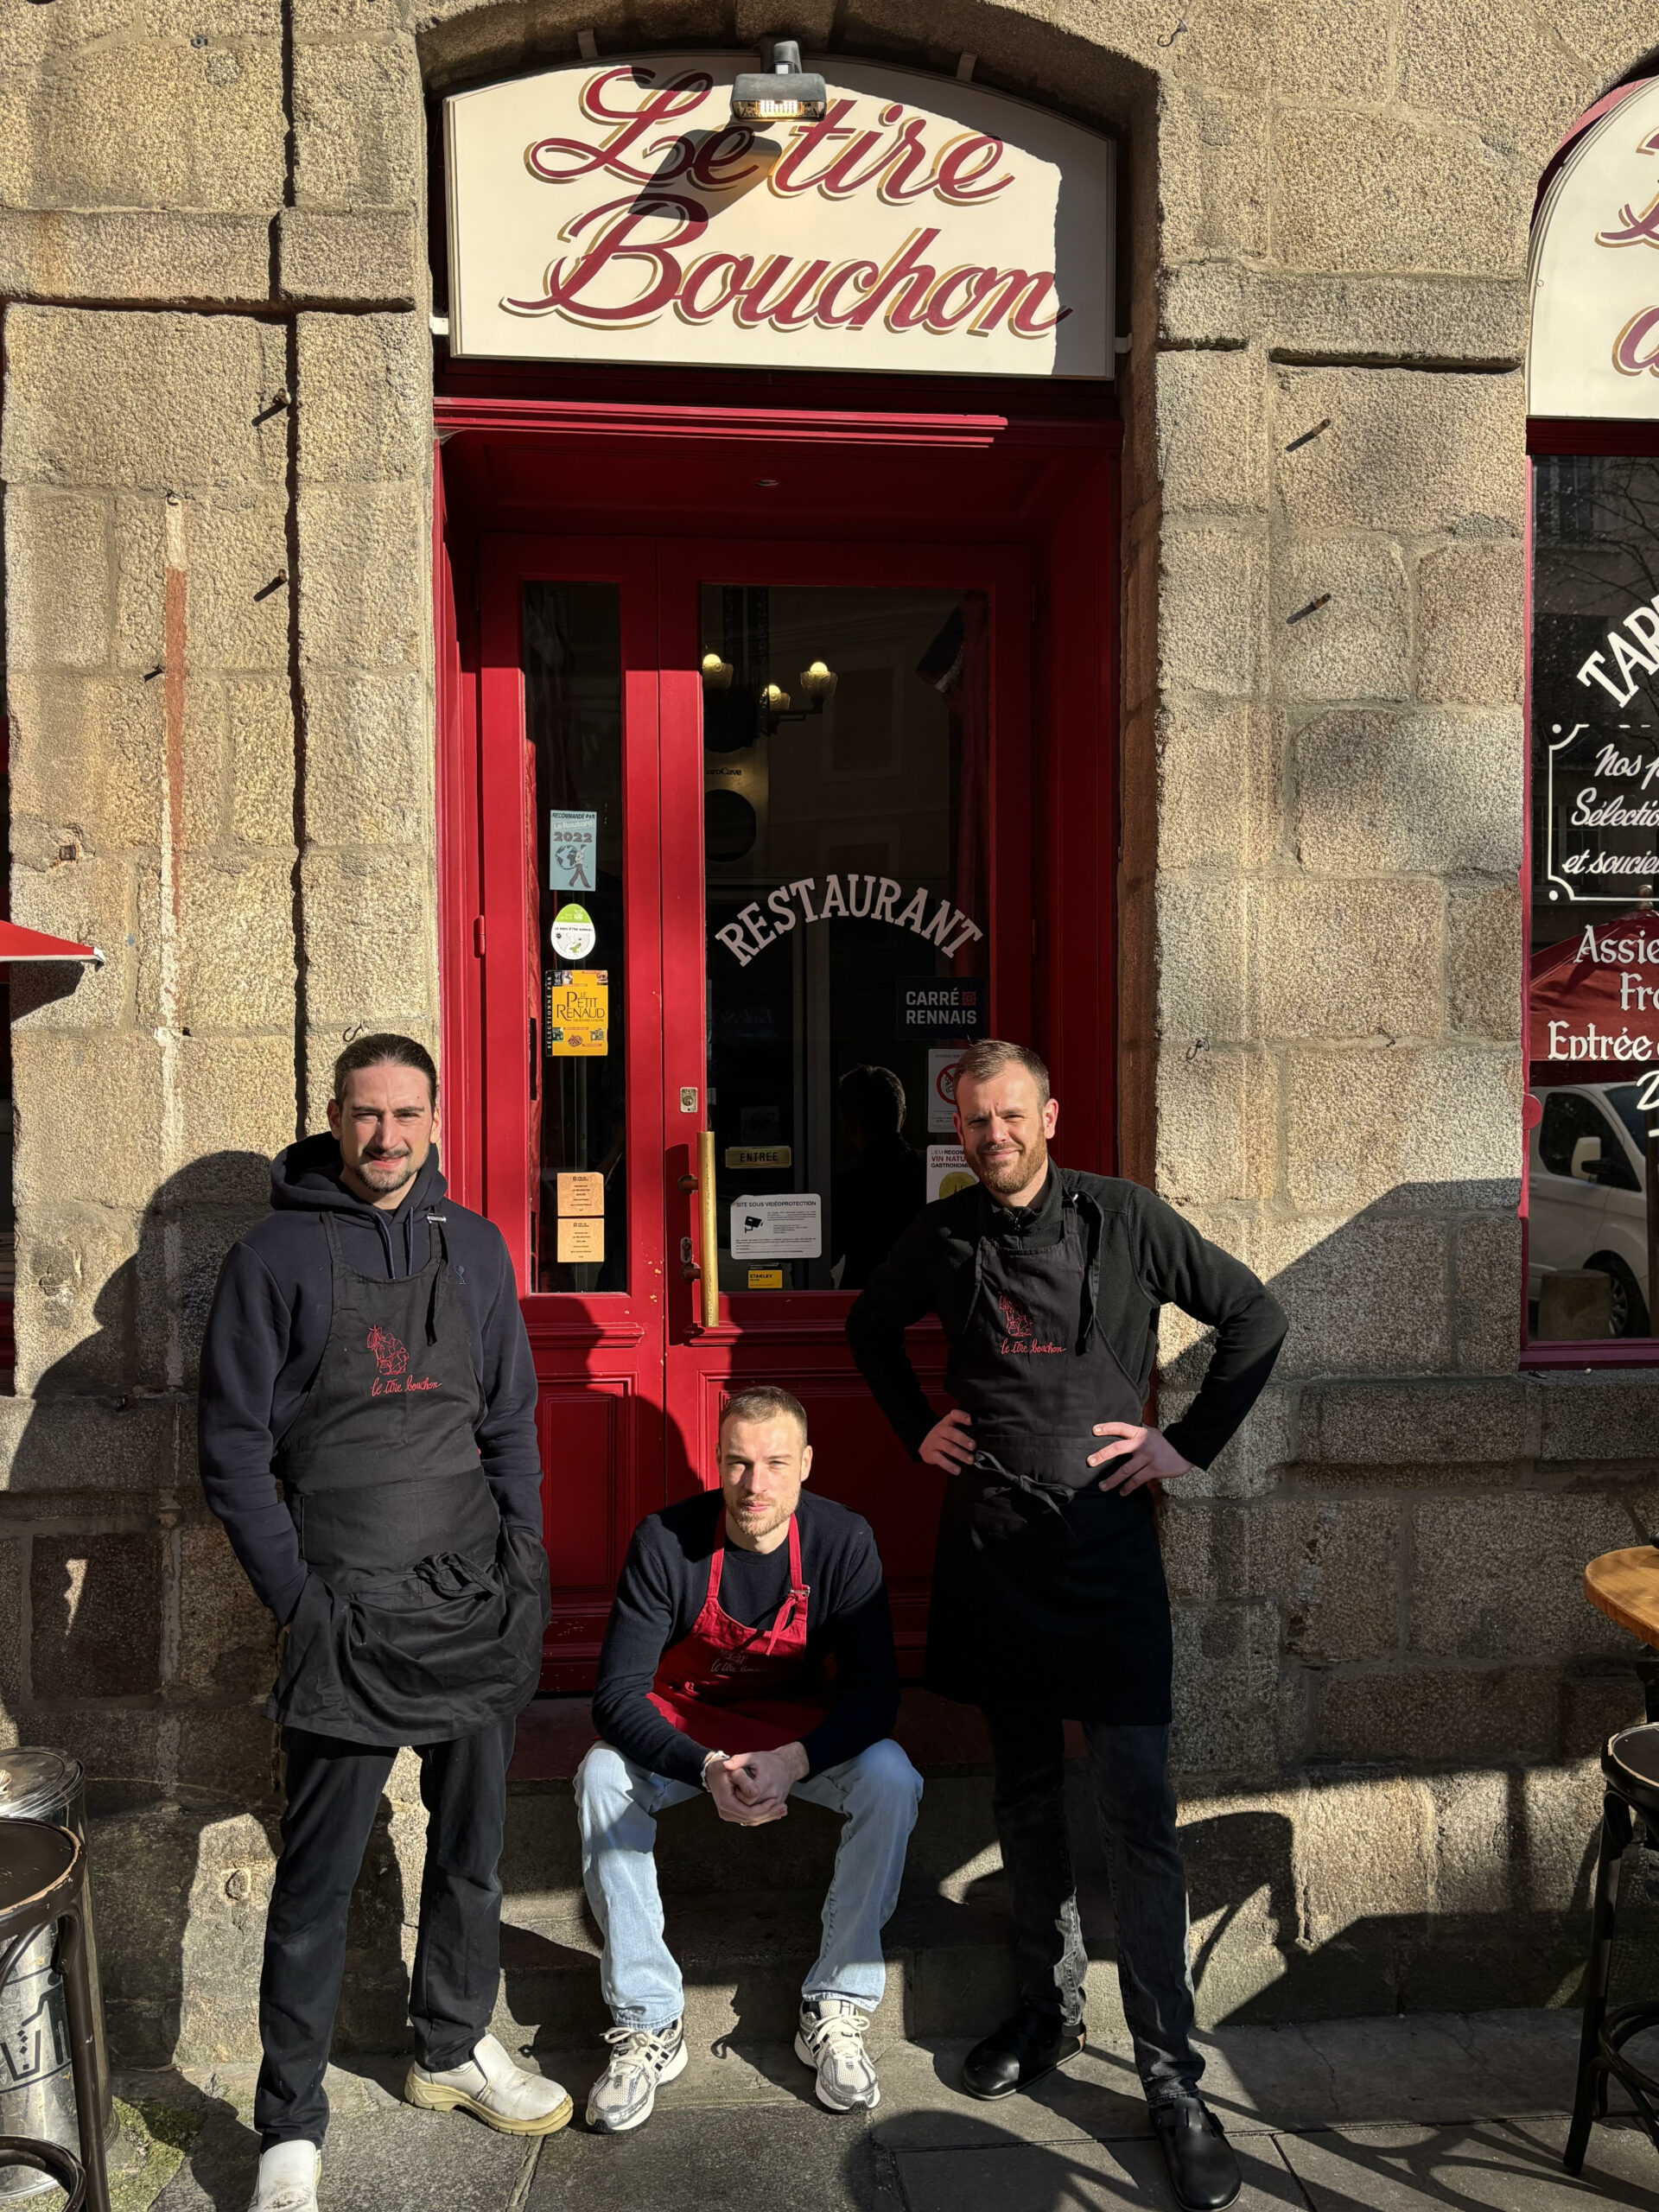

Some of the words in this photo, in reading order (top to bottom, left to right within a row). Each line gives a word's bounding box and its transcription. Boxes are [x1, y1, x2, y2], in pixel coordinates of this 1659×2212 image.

[524, 65, 760, 192] Le
[767, 99, 1016, 207] tire
[498, 193, 1073, 338] Bouchon
[1594, 743, 1643, 777] Nos
[553, 831, 593, 843] 2022
[1561, 849, 1590, 874] et
[715, 874, 983, 968] RESTAURANT
[567, 991, 598, 1007] PETIT
[906, 988, 959, 1006] CARRÉ
[1619, 971, 1659, 1012] Fr
[556, 1004, 605, 1021] RENAUD
[906, 1009, 976, 1025] RENNAIS
[1547, 1020, 1654, 1062] Entrée
